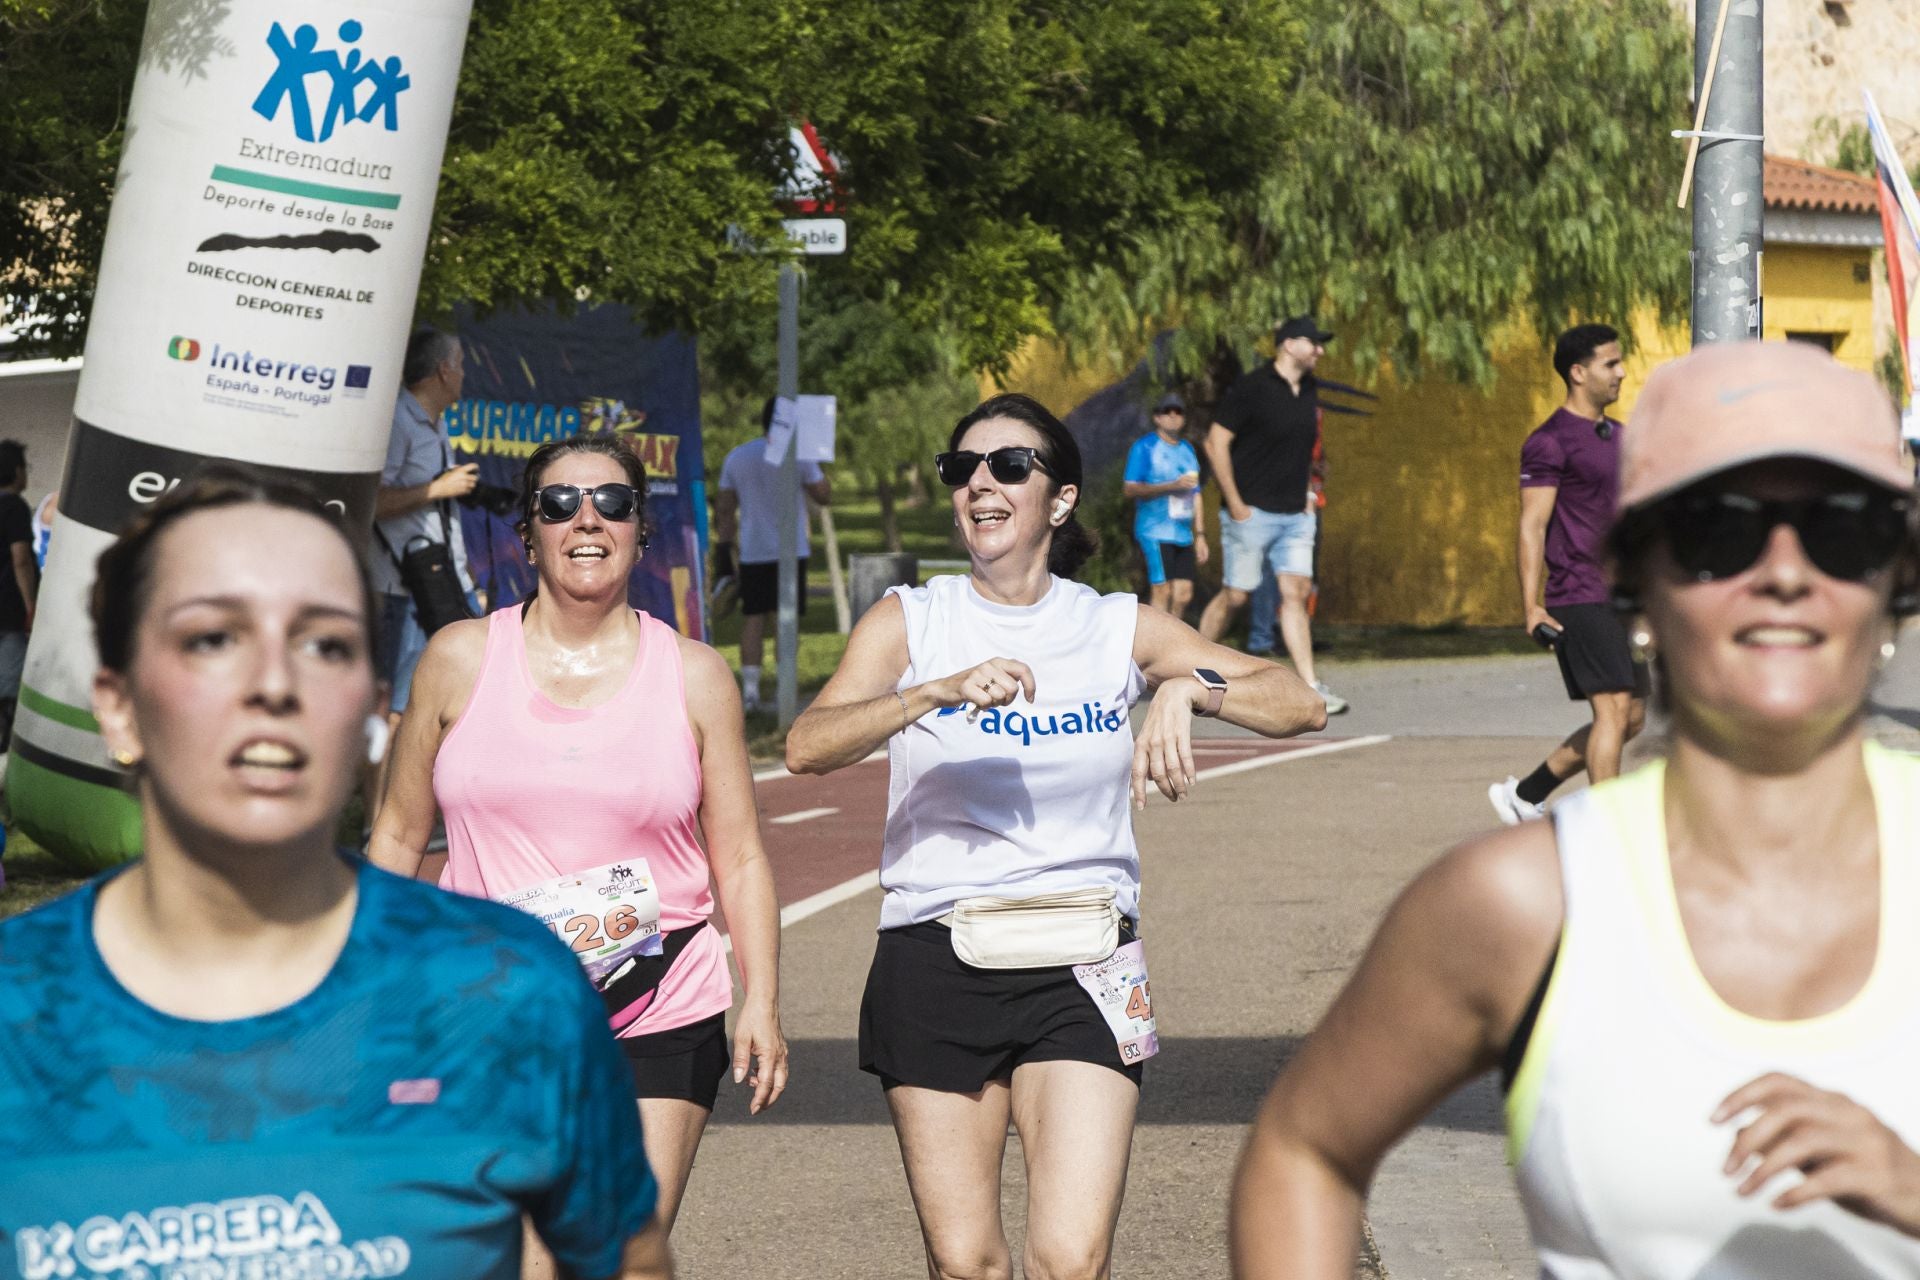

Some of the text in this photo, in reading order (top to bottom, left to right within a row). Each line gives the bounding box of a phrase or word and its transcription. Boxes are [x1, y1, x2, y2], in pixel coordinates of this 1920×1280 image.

[239, 137, 392, 180] Extremadura
[203, 185, 394, 230] Deporte desde la Base
[187, 261, 375, 303] DIRECCION GENERAL DE
[236, 294, 324, 320] DEPORTES
[209, 343, 337, 391] Interreg
[206, 374, 260, 395] España
[274, 386, 333, 407] Portugal
[444, 398, 580, 443] BURMAR
[980, 701, 1121, 746] aqualia
[502, 887, 546, 907] ARRERA
[597, 878, 642, 897] CIRCUIT
[73, 1190, 342, 1273] CARRERA
